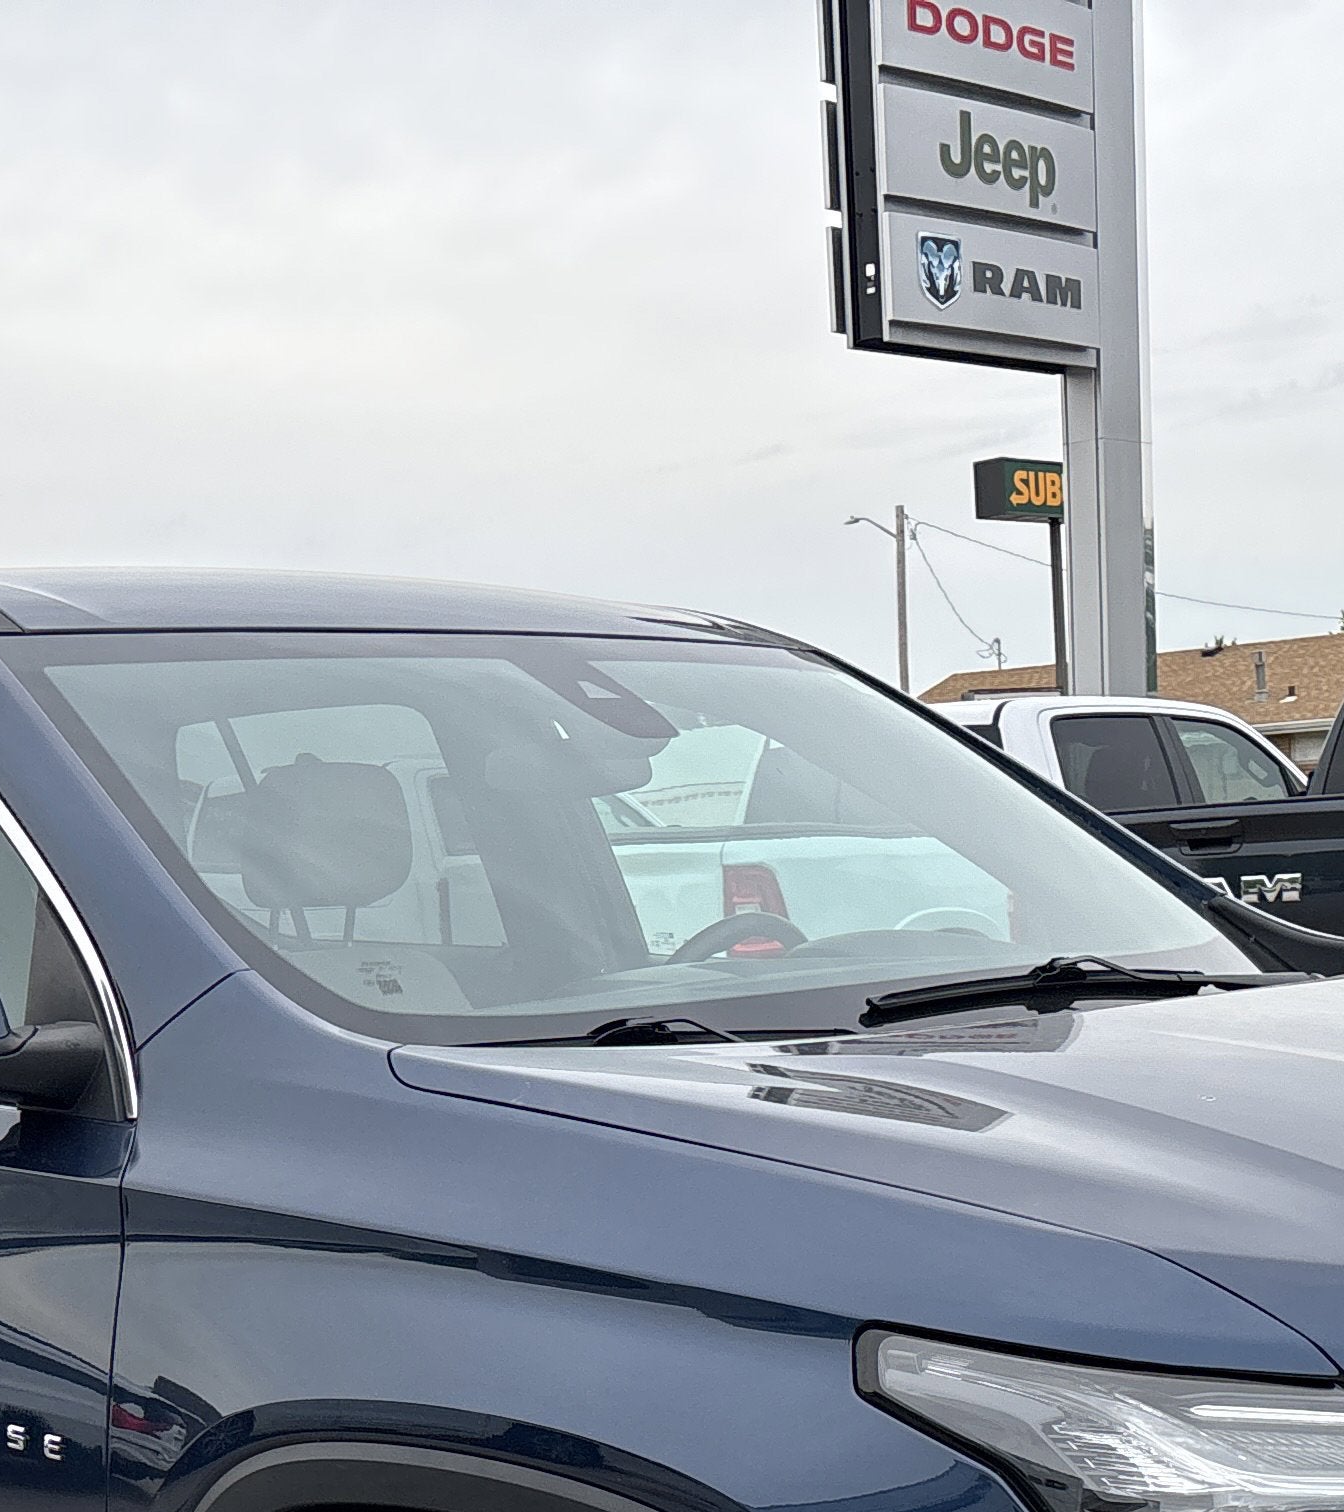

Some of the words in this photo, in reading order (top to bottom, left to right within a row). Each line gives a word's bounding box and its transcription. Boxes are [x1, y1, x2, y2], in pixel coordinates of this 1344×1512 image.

[907, 0, 1076, 72] DODGE
[939, 109, 1056, 208] Jeep
[972, 260, 1082, 310] RAM
[1009, 470, 1062, 507] SUB
